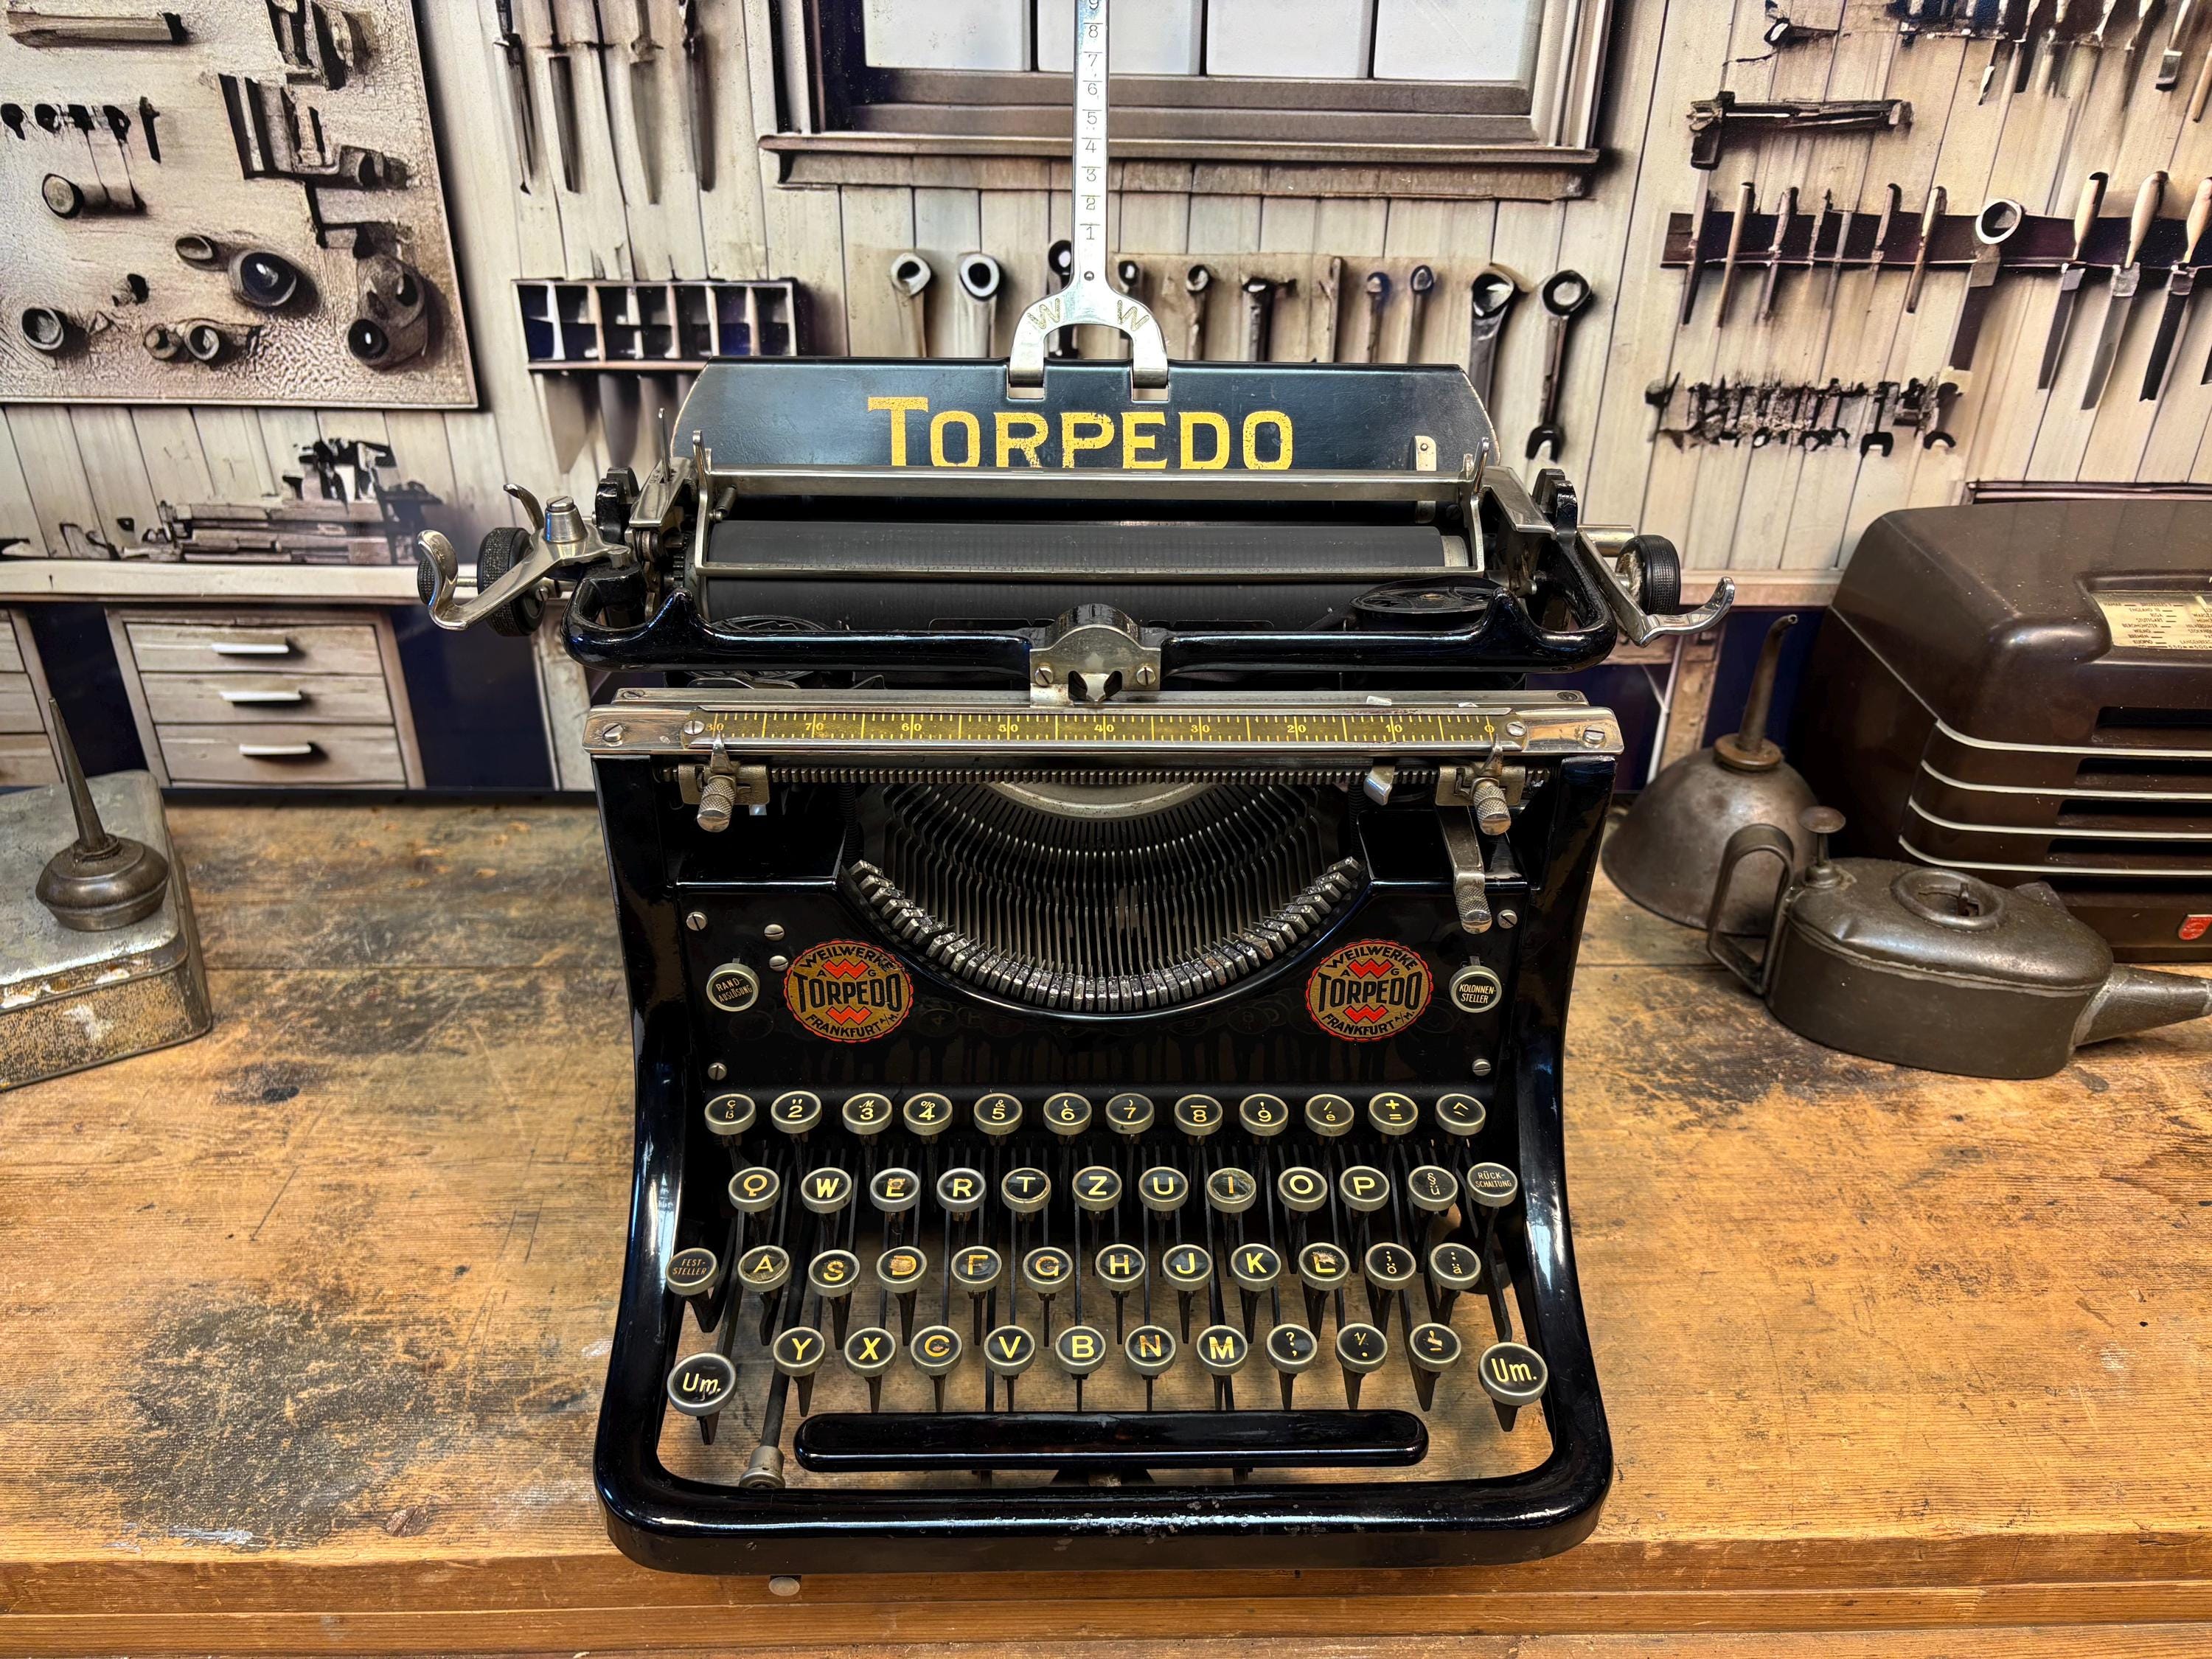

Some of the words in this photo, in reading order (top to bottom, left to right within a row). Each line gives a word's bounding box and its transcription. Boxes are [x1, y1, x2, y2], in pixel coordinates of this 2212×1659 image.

[1088, 24, 1099, 38] 8
[1088, 54, 1097, 66] 7
[1088, 83, 1098, 95] 6
[1087, 111, 1097, 125] 5
[1085, 139, 1096, 153] 4
[1086, 168, 1096, 181] 3
[1086, 198, 1096, 210] 2
[1086, 226, 1095, 240] 1
[867, 396, 1293, 470] TORPEDO
[706, 722, 724, 731] 80
[805, 722, 824, 731] 70
[902, 723, 922, 731] 60
[998, 724, 1018, 732] 50
[1094, 724, 1114, 732] 40
[1191, 724, 1210, 732] 30
[1287, 725, 1307, 733] 20
[1387, 724, 1402, 733] 10
[1484, 724, 1495, 733] 0
[1325, 945, 1418, 971] WEILWERKE
[868, 969, 877, 977] G
[1340, 969, 1351, 977] A
[715, 978, 744, 992] RAND-
[1318, 970, 1423, 1012] TORPEDO
[1458, 983, 1496, 995] KOLONNEN-
[717, 984, 753, 1004] AUSLÖSUNG
[793, 971, 902, 1013] TORPEDO
[1461, 992, 1489, 1004] STELLER
[805, 1014, 883, 1037] FRANKFURT
[1321, 1013, 1397, 1036] FRANKFURT
[920, 1100, 935, 1109] %
[995, 1099, 1006, 1108] &
[787, 1105, 803, 1119] 2
[860, 1107, 874, 1120] 3
[918, 1107, 935, 1121] 4
[992, 1107, 1006, 1120] 5
[1061, 1108, 1075, 1121] 6
[1123, 1107, 1136, 1119] 7
[1193, 1109, 1207, 1123] 8
[1257, 1110, 1272, 1122] 9
[1427, 1172, 1437, 1186] §
[1477, 1170, 1505, 1180] RÜCK-
[743, 1174, 768, 1197] Q
[815, 1178, 839, 1198] W
[886, 1178, 905, 1197] E
[952, 1178, 973, 1197] R
[1016, 1176, 1036, 1192] T
[1088, 1175, 1107, 1195] Z
[1152, 1177, 1175, 1195] U
[1228, 1176, 1234, 1194] I
[1289, 1175, 1314, 1194] O
[1352, 1176, 1376, 1196] P
[1429, 1186, 1440, 1195] ü
[1475, 1180, 1512, 1188] SCHALTUNG
[681, 1258, 706, 1267] FEST-
[753, 1254, 774, 1273] A
[823, 1260, 844, 1281] S
[891, 1255, 917, 1276] D
[967, 1254, 989, 1276] F
[1035, 1256, 1060, 1276] G
[1109, 1254, 1130, 1275] H
[1175, 1252, 1195, 1274] J
[1245, 1253, 1267, 1273] K
[1386, 1262, 1397, 1274] ö
[1451, 1263, 1462, 1275] ä
[672, 1267, 707, 1276] STELLER
[1286, 1332, 1295, 1346] ?
[791, 1338, 813, 1360] Y
[858, 1337, 881, 1360] X
[924, 1335, 950, 1357] C
[998, 1335, 1021, 1358] V
[1071, 1335, 1094, 1358] B
[1139, 1335, 1162, 1357] N
[1208, 1336, 1235, 1360] M
[1491, 1357, 1537, 1382] Um.
[683, 1372, 721, 1393] Um.
